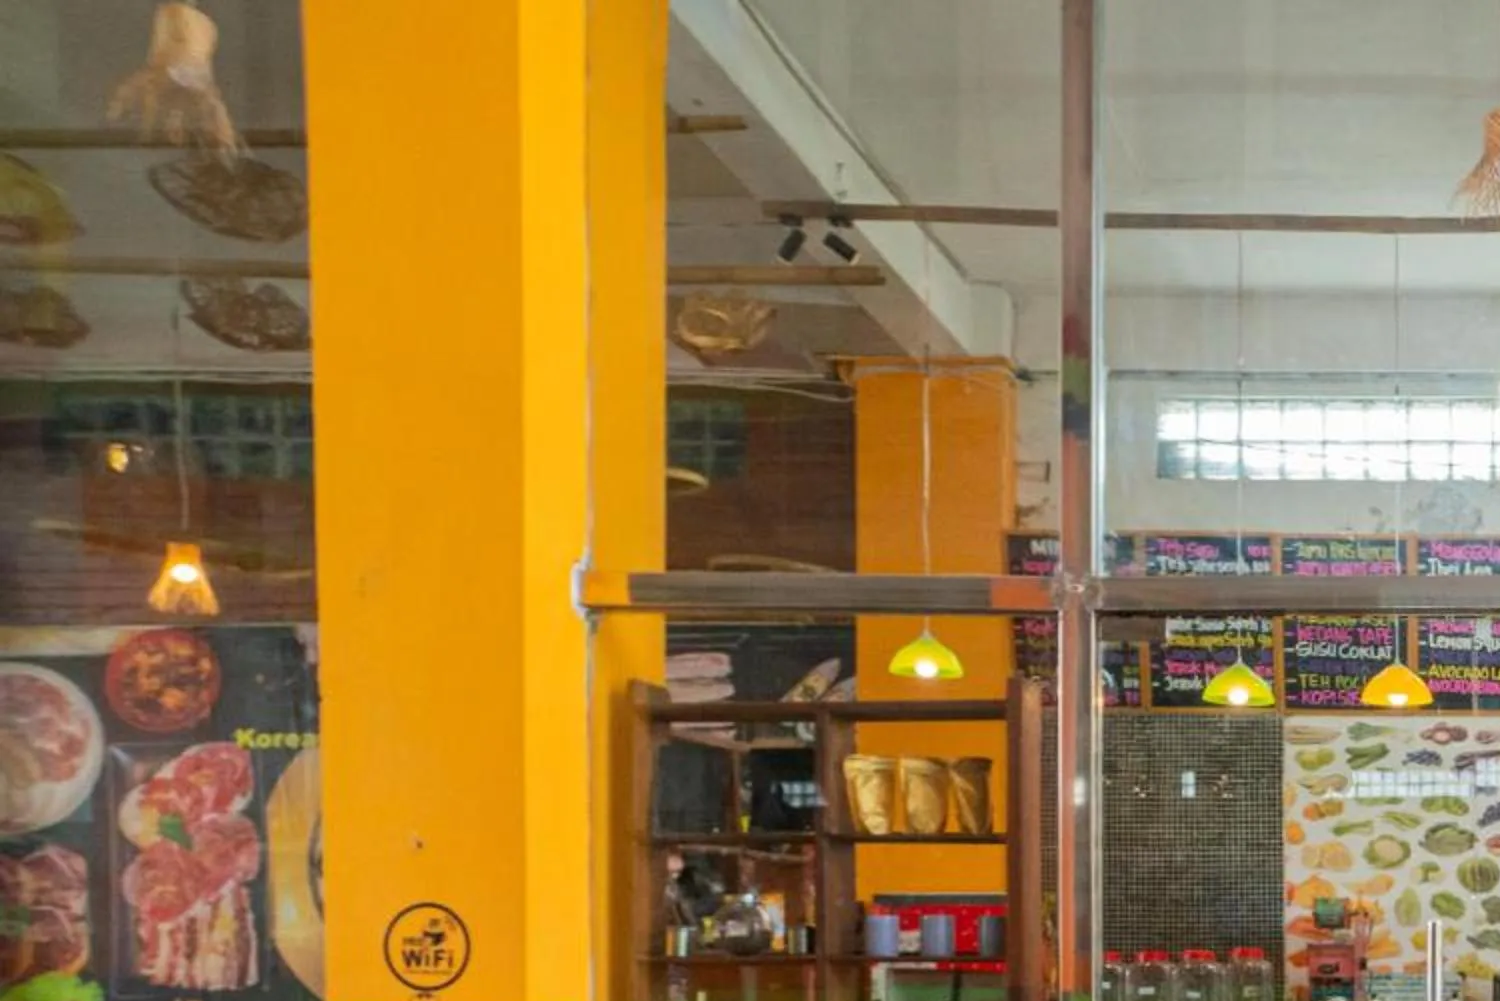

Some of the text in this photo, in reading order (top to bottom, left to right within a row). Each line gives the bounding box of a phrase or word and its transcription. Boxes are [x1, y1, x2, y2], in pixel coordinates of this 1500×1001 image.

[1339, 643, 1393, 661] COKLAT
[1300, 674, 1330, 689] TEH
[235, 728, 317, 749] Korea
